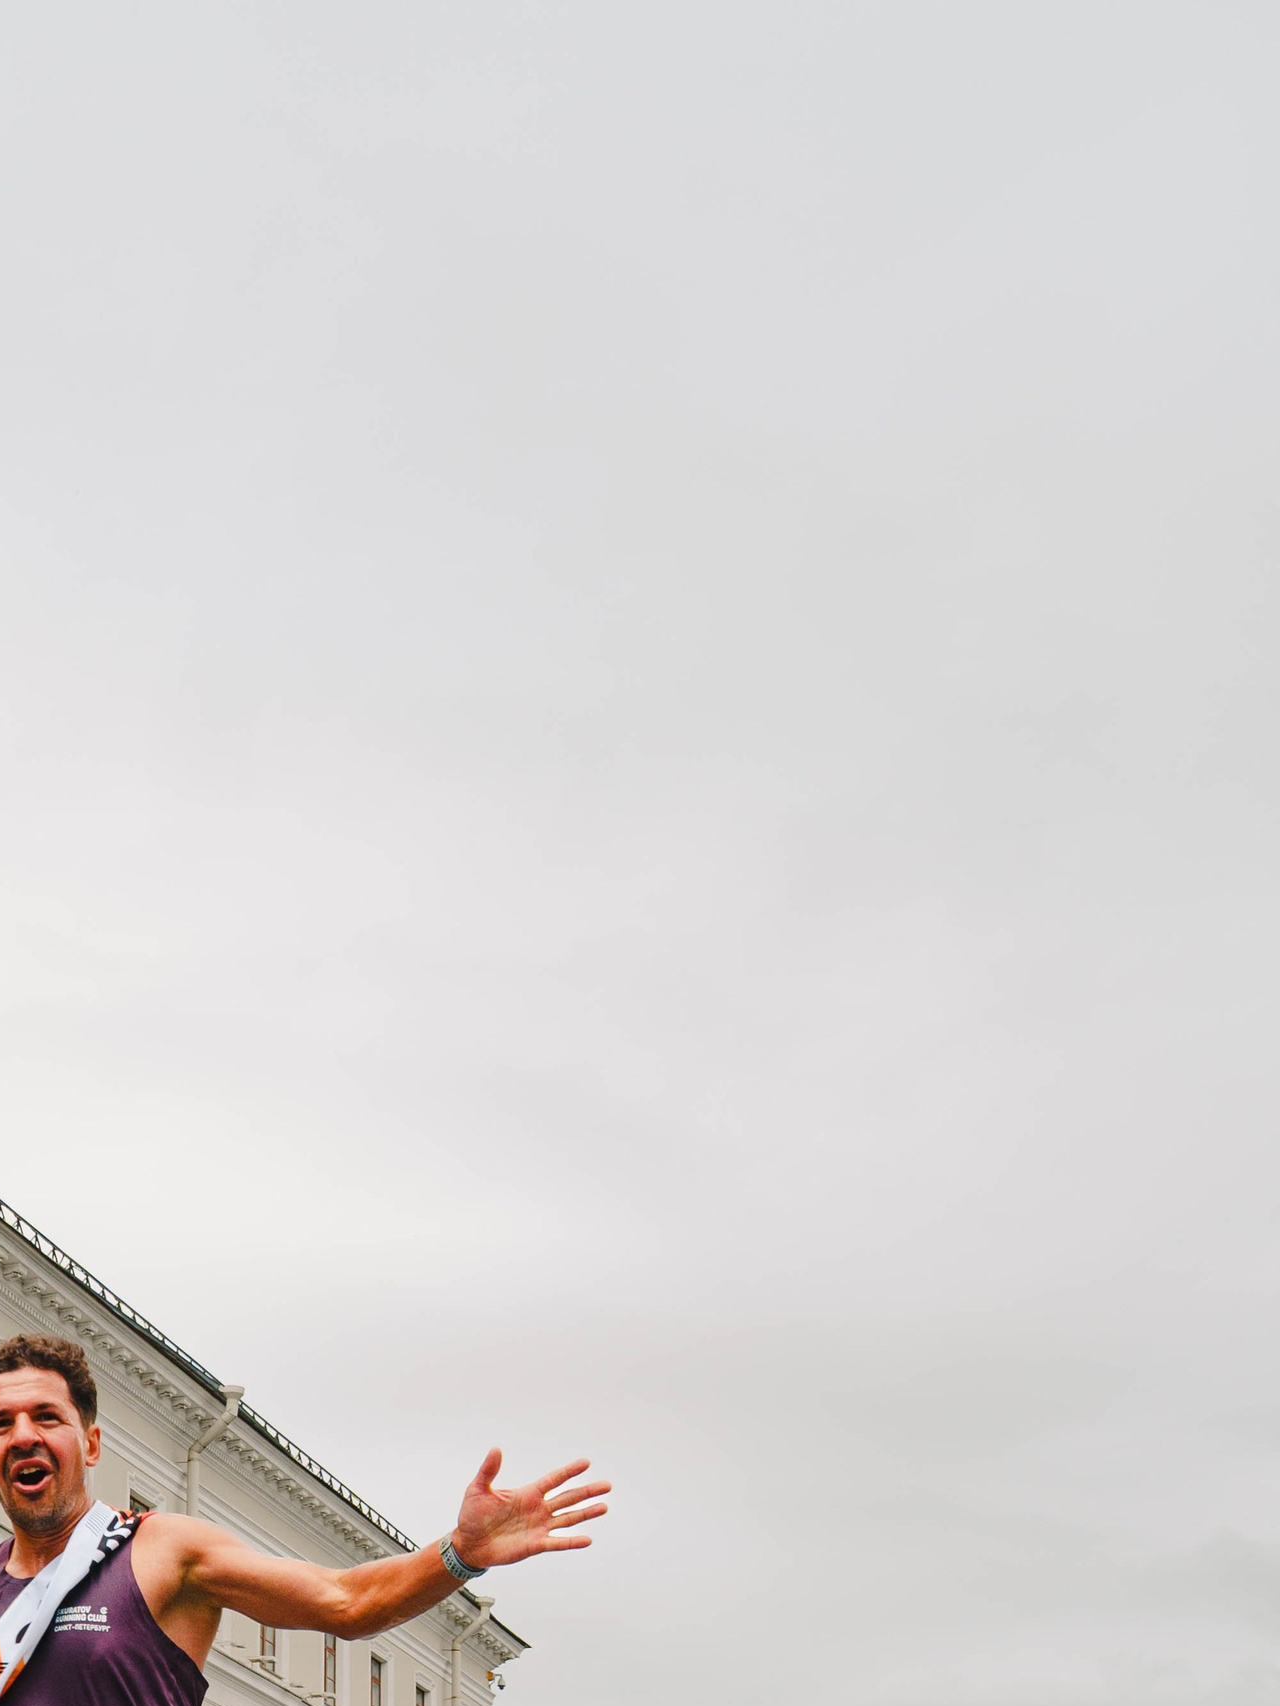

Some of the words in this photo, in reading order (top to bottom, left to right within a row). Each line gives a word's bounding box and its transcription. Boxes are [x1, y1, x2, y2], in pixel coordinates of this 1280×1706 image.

[55, 1614, 86, 1623] RUNNING
[87, 1614, 107, 1622] CLUB
[54, 1624, 111, 1632] САНКТ-ПЕТЕРБУРГ
